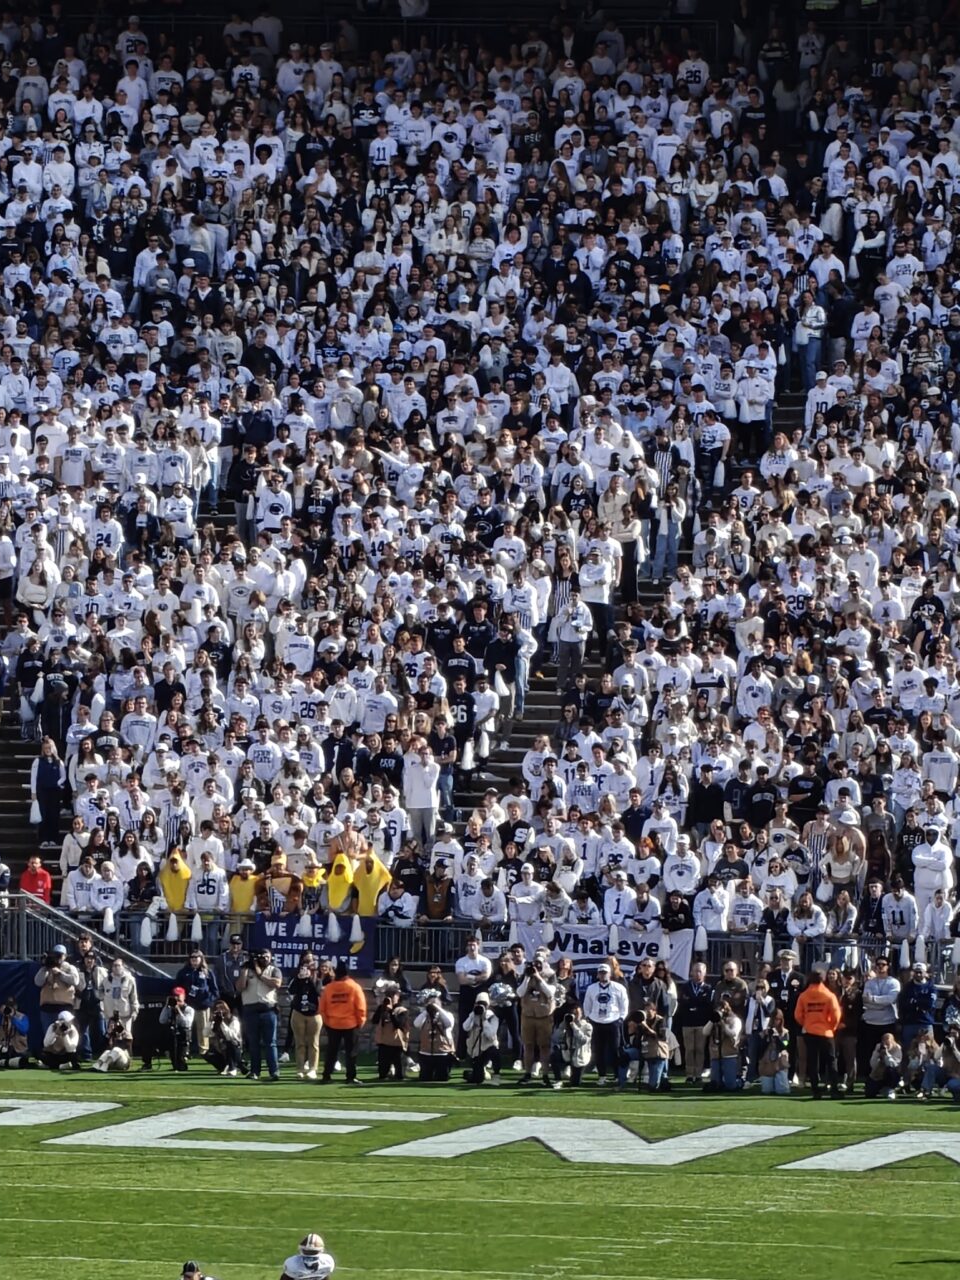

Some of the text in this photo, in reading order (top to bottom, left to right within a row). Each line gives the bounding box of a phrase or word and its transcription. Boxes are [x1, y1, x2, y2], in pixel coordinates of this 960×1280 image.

[686, 69, 701, 84] 26
[376, 147, 386, 161] 11
[584, 254, 589, 269] 1
[912, 312, 916, 326] 1
[62, 357, 71, 370] P
[201, 427, 205, 442] 1
[561, 472, 570, 487] 4
[741, 496, 748, 508] S
[96, 533, 111, 547] 24
[300, 701, 316, 719] 26
[564, 768, 576, 783] 11
[649, 770, 654, 786] 1
[514, 827, 528, 844] S
[581, 843, 587, 860] 1
[197, 879, 216, 895] 26
[614, 898, 620, 914] 1
[891, 910, 905, 925] 11
[264, 921, 287, 937] WE
